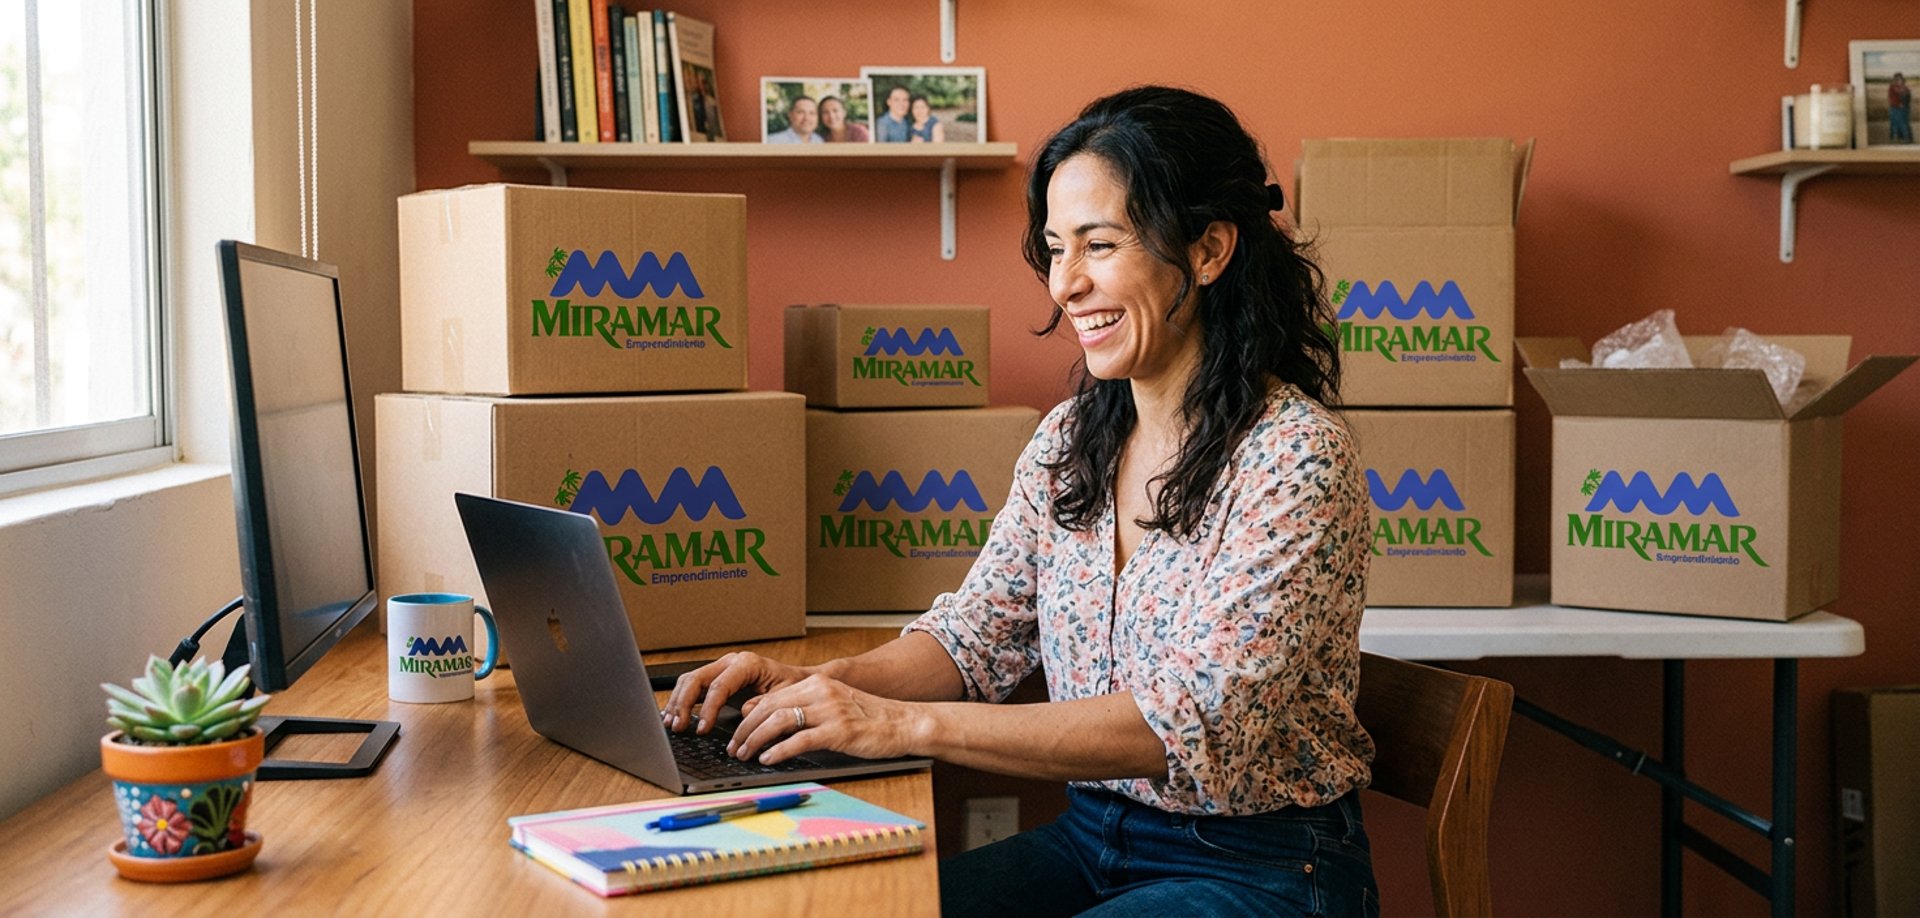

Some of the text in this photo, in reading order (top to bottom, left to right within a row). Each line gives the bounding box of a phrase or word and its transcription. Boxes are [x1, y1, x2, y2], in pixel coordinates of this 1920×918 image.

[531, 300, 733, 349] MIRAMAR
[853, 357, 982, 386] MIRAMAR
[603, 528, 781, 586] RAMAR
[1371, 518, 1495, 557] AMAR
[1567, 514, 1770, 568] MIRAMAR
